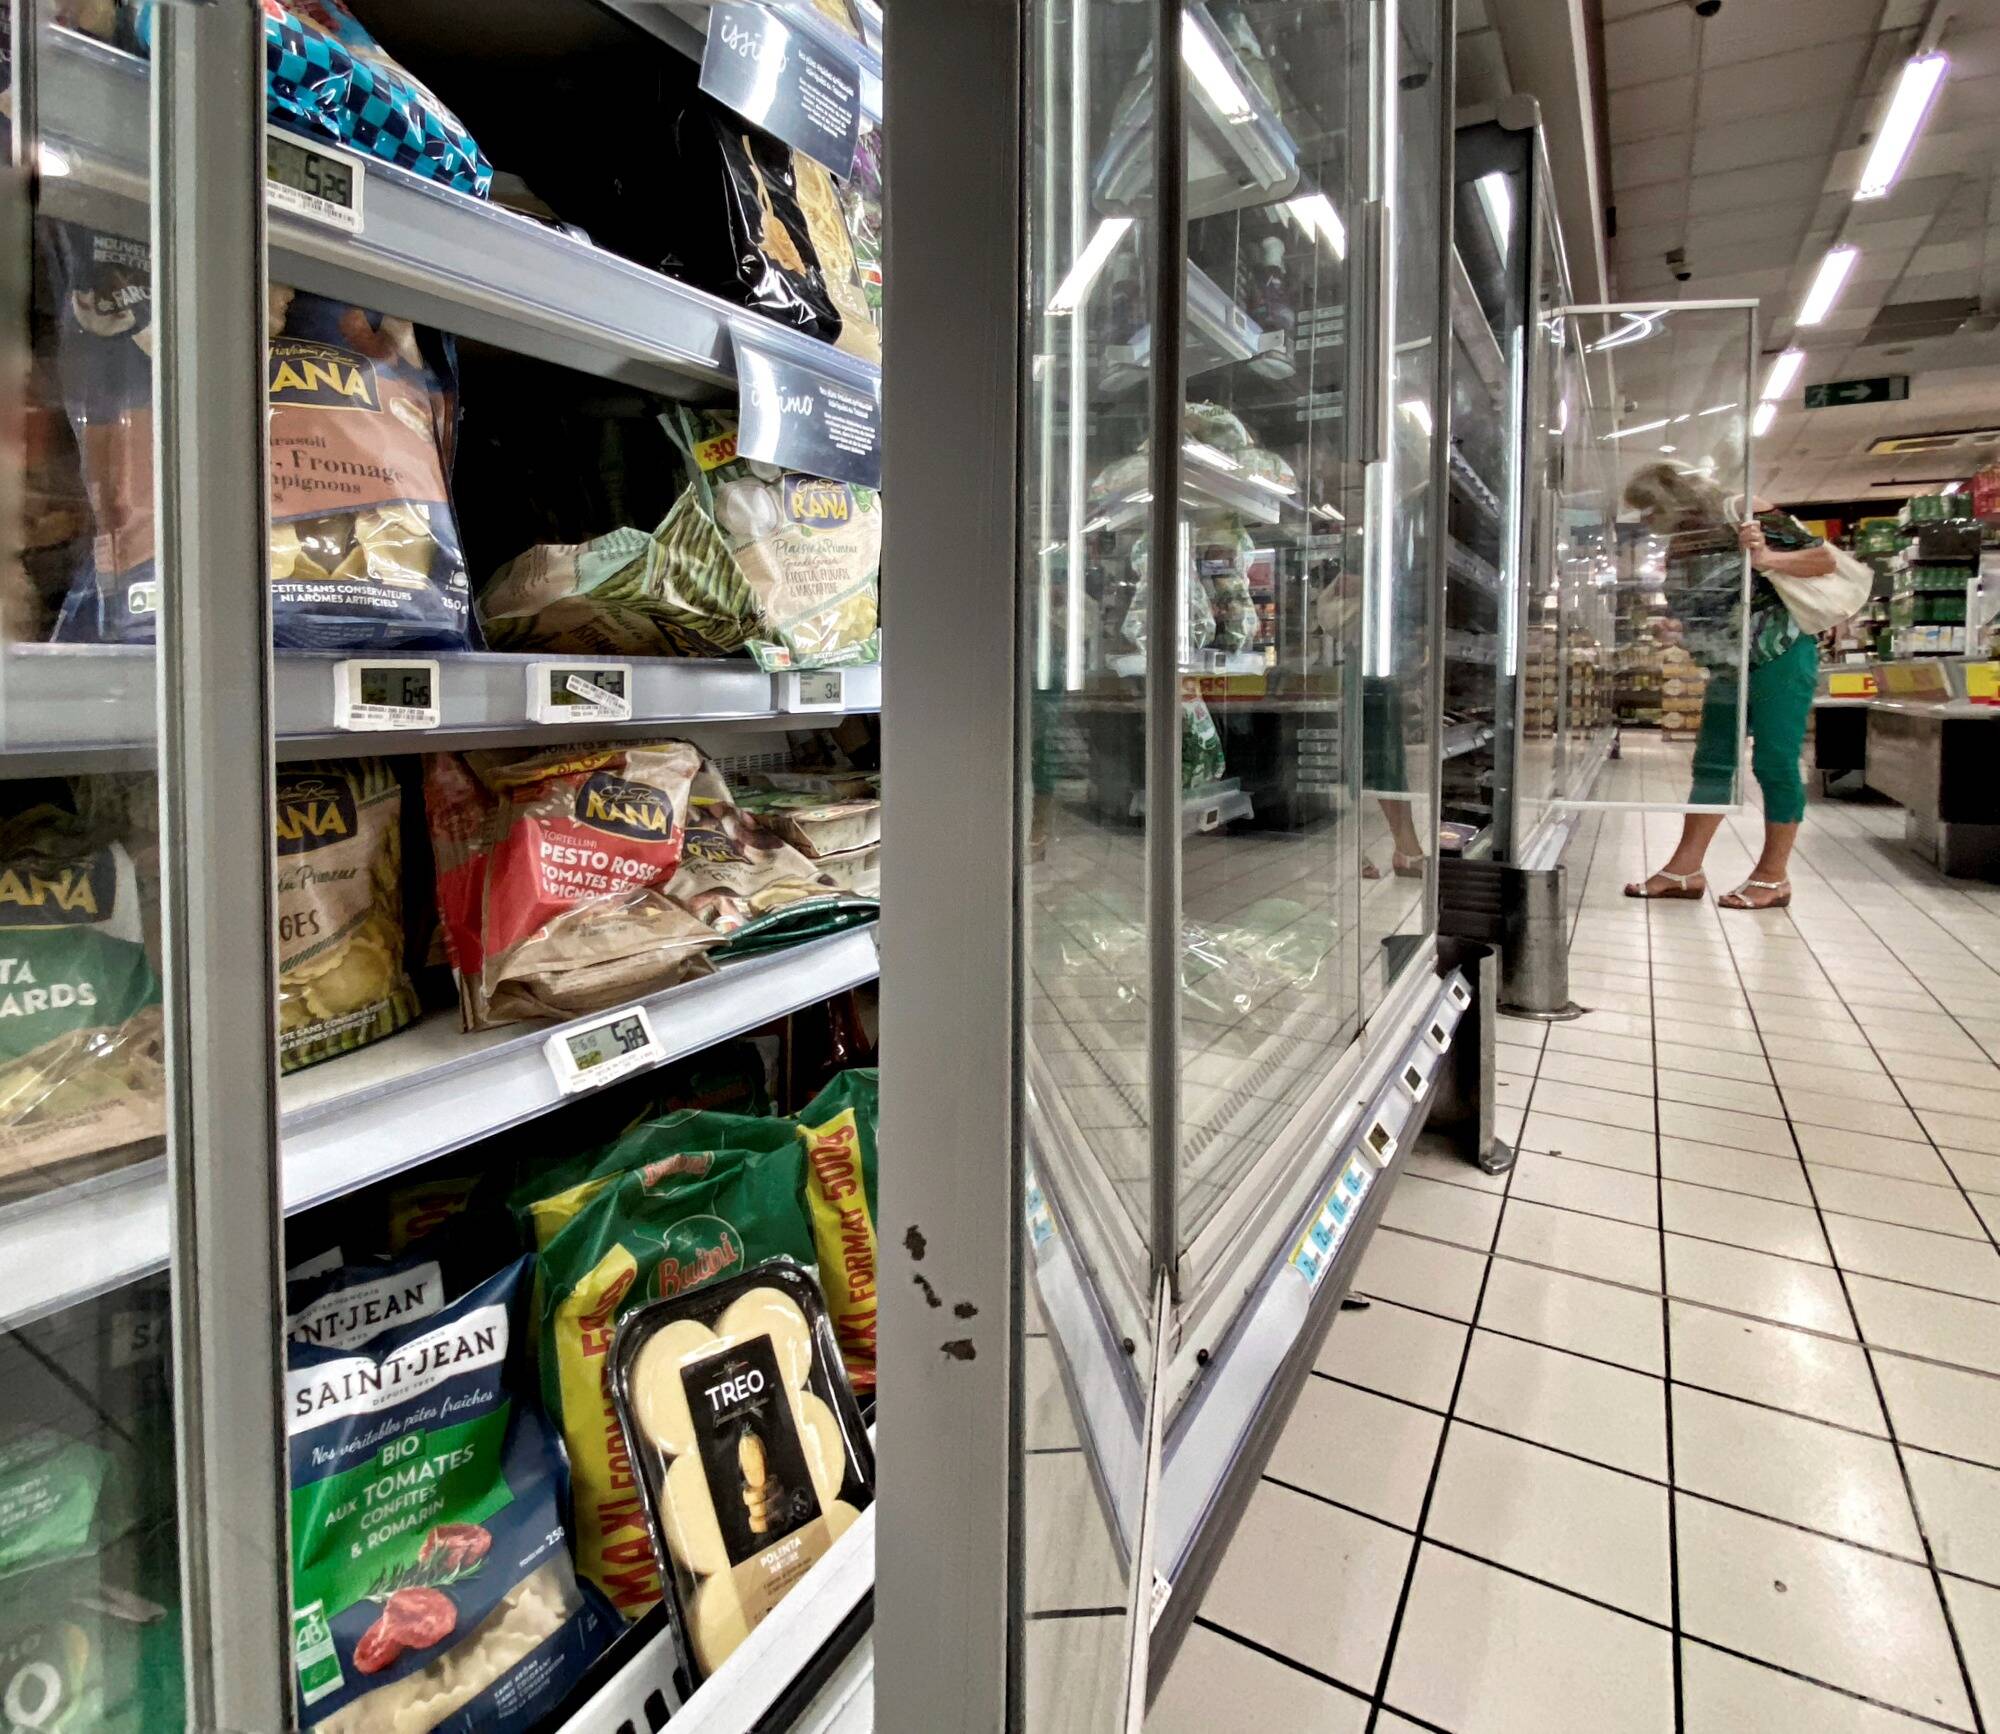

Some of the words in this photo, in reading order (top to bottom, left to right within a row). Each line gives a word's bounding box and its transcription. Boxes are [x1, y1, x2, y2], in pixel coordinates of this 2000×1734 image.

[720, 15, 789, 73] issio
[791, 491, 849, 521] RANA
[281, 594, 294, 602] NI
[298, 591, 343, 603] ARÔMES
[346, 596, 399, 608] ARTIFICIELS
[307, 584, 336, 593] SANS
[338, 585, 412, 601] CONSERVATEURS
[586, 789, 667, 835] RANA
[541, 842, 609, 870] PESTO
[543, 830, 598, 849] TORTELLINI
[541, 862, 607, 889] TOMATES
[839, 1207, 876, 1304] FORMAT
[704, 1369, 765, 1411] TREO
[311, 1446, 335, 1467] Nos
[340, 1419, 401, 1455] véritables
[403, 1406, 437, 1432] pâtes
[440, 1388, 494, 1419] fraîches
[382, 1435, 420, 1468] BIO
[363, 1443, 475, 1506] TOMATES
[324, 1498, 358, 1528] AUX
[360, 1483, 439, 1530] CONFITES
[351, 1542, 363, 1559] &
[367, 1498, 445, 1549] ROMARIN
[598, 1497, 664, 1609] MAXI
